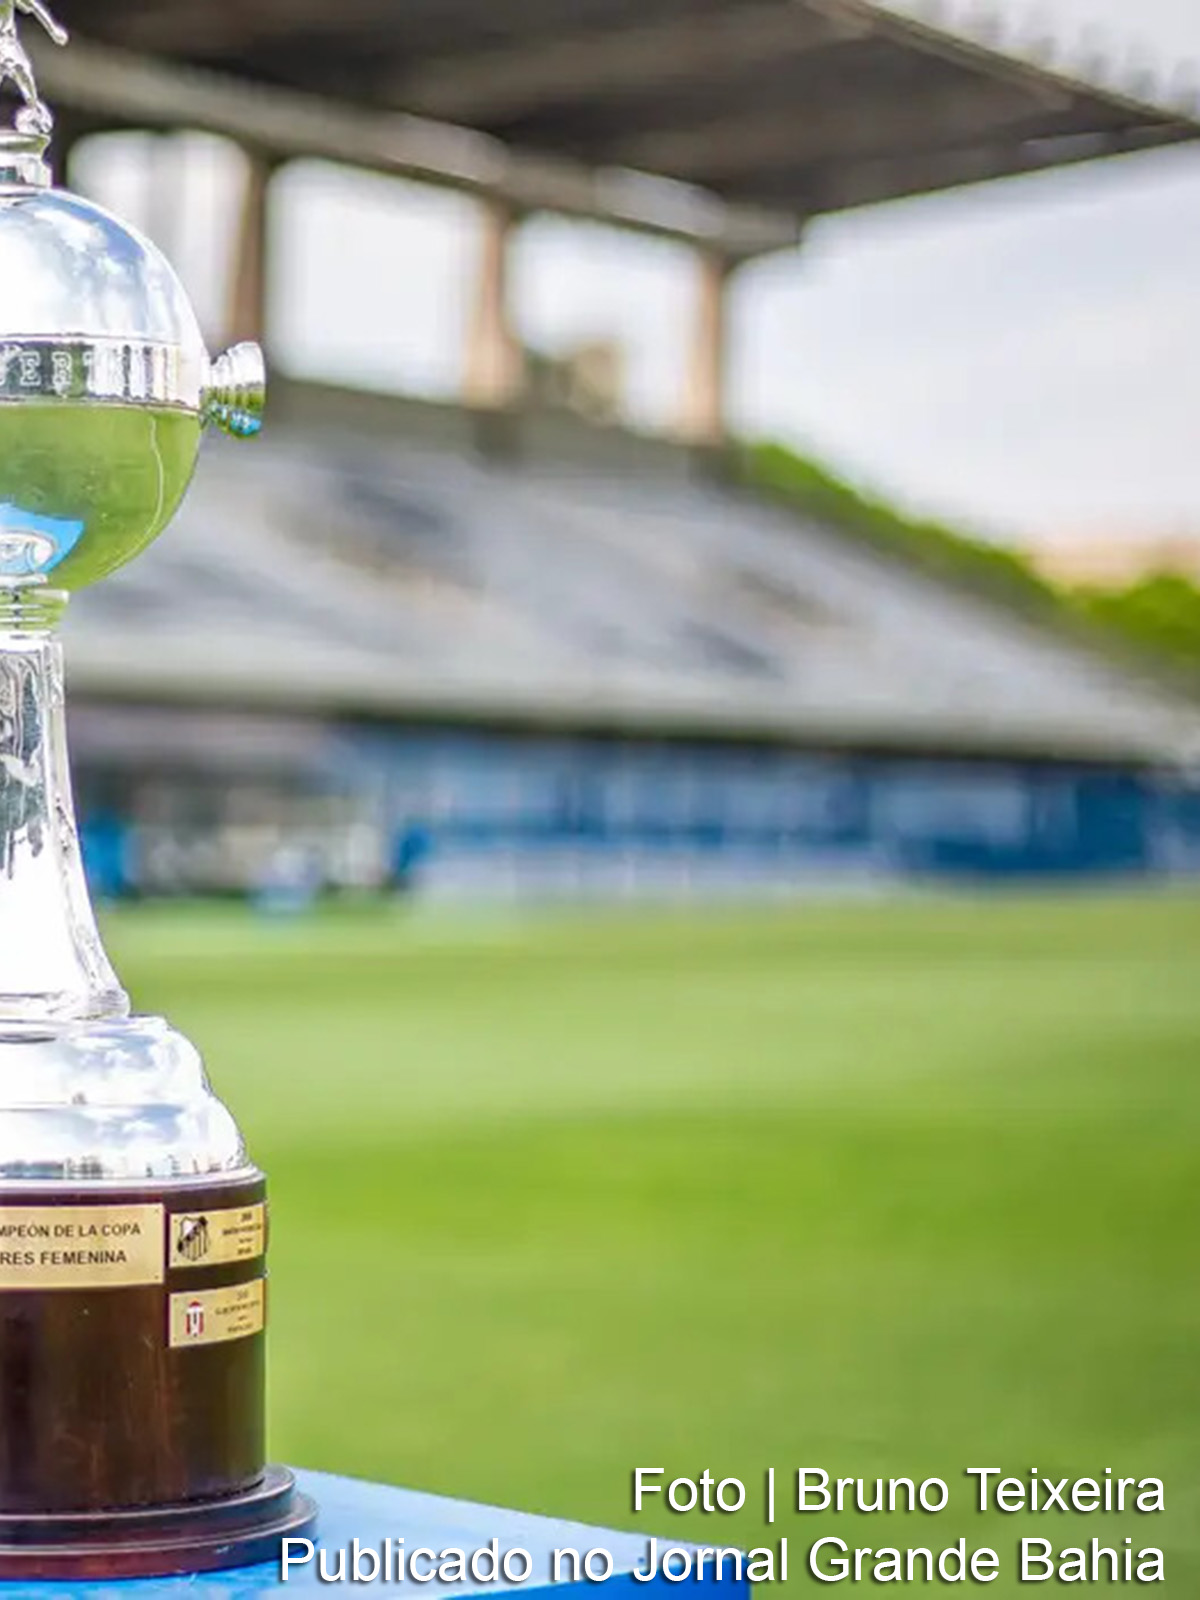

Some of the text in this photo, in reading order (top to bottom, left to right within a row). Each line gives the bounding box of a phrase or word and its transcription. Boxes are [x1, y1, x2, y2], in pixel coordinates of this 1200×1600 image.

[54, 1224, 74, 1238] DE
[78, 1224, 98, 1238] LA
[101, 1222, 141, 1237] COPA
[40, 1249, 127, 1265] FEMENINA
